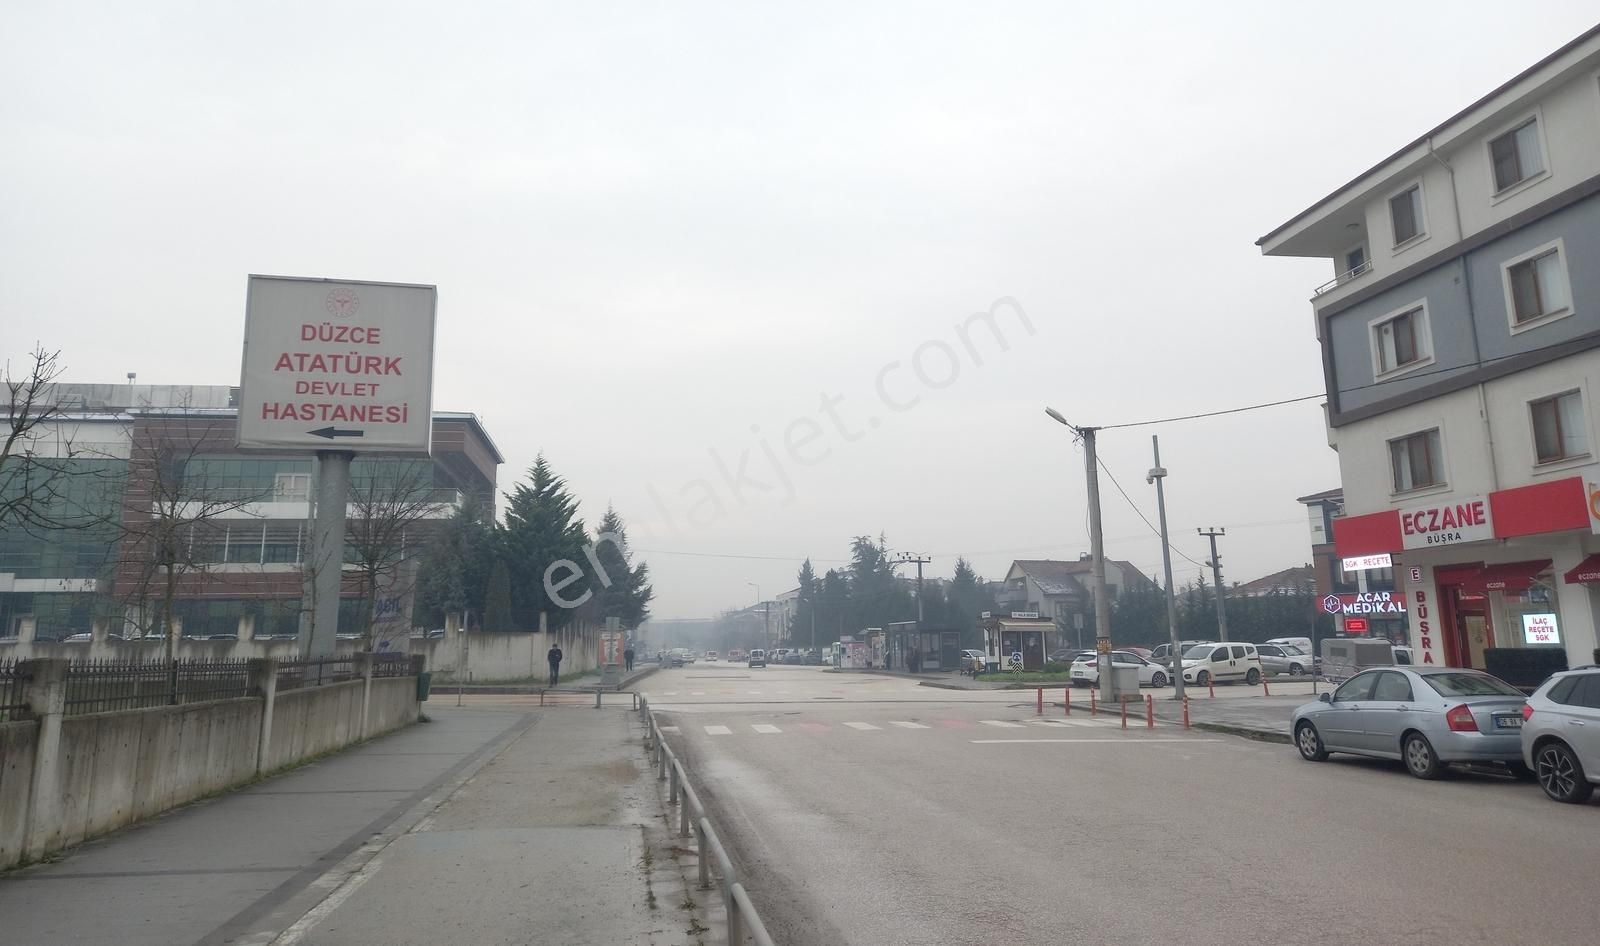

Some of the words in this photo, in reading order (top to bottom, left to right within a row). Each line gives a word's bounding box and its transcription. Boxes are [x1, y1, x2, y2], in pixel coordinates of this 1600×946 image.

[301, 322, 381, 345] DÜZCE
[274, 351, 402, 376] ATATÜRK
[295, 381, 380, 397] DEVLET
[261, 402, 408, 424] HASTANESİ
[1402, 501, 1486, 535] ECZANE
[1427, 532, 1462, 544] BÜŞRA
[1356, 592, 1391, 602] ACAR
[1416, 591, 1434, 664] BÜŞRA
